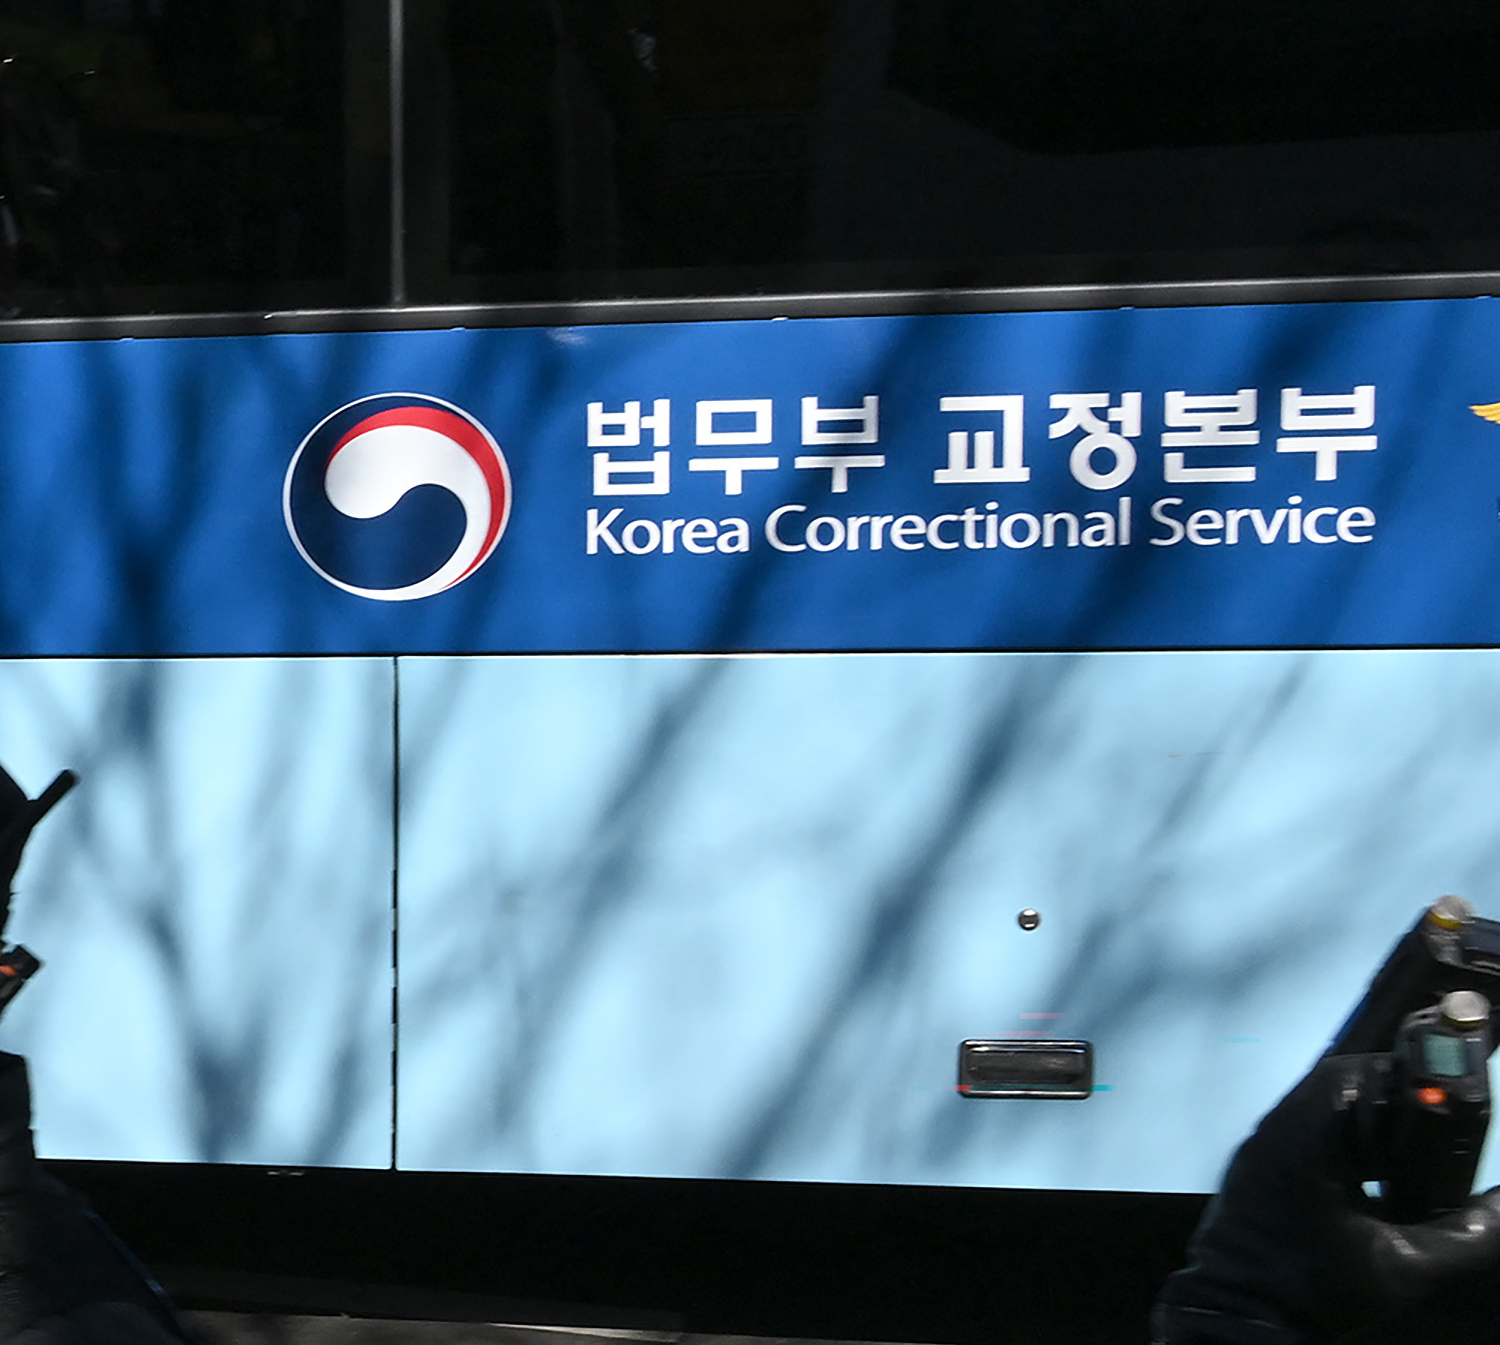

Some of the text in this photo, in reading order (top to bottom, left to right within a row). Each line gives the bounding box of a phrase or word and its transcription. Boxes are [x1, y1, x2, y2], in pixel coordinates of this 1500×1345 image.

[586, 385, 1378, 497] 법무부 교정본부
[586, 493, 1378, 556] Korea Correctional Service
